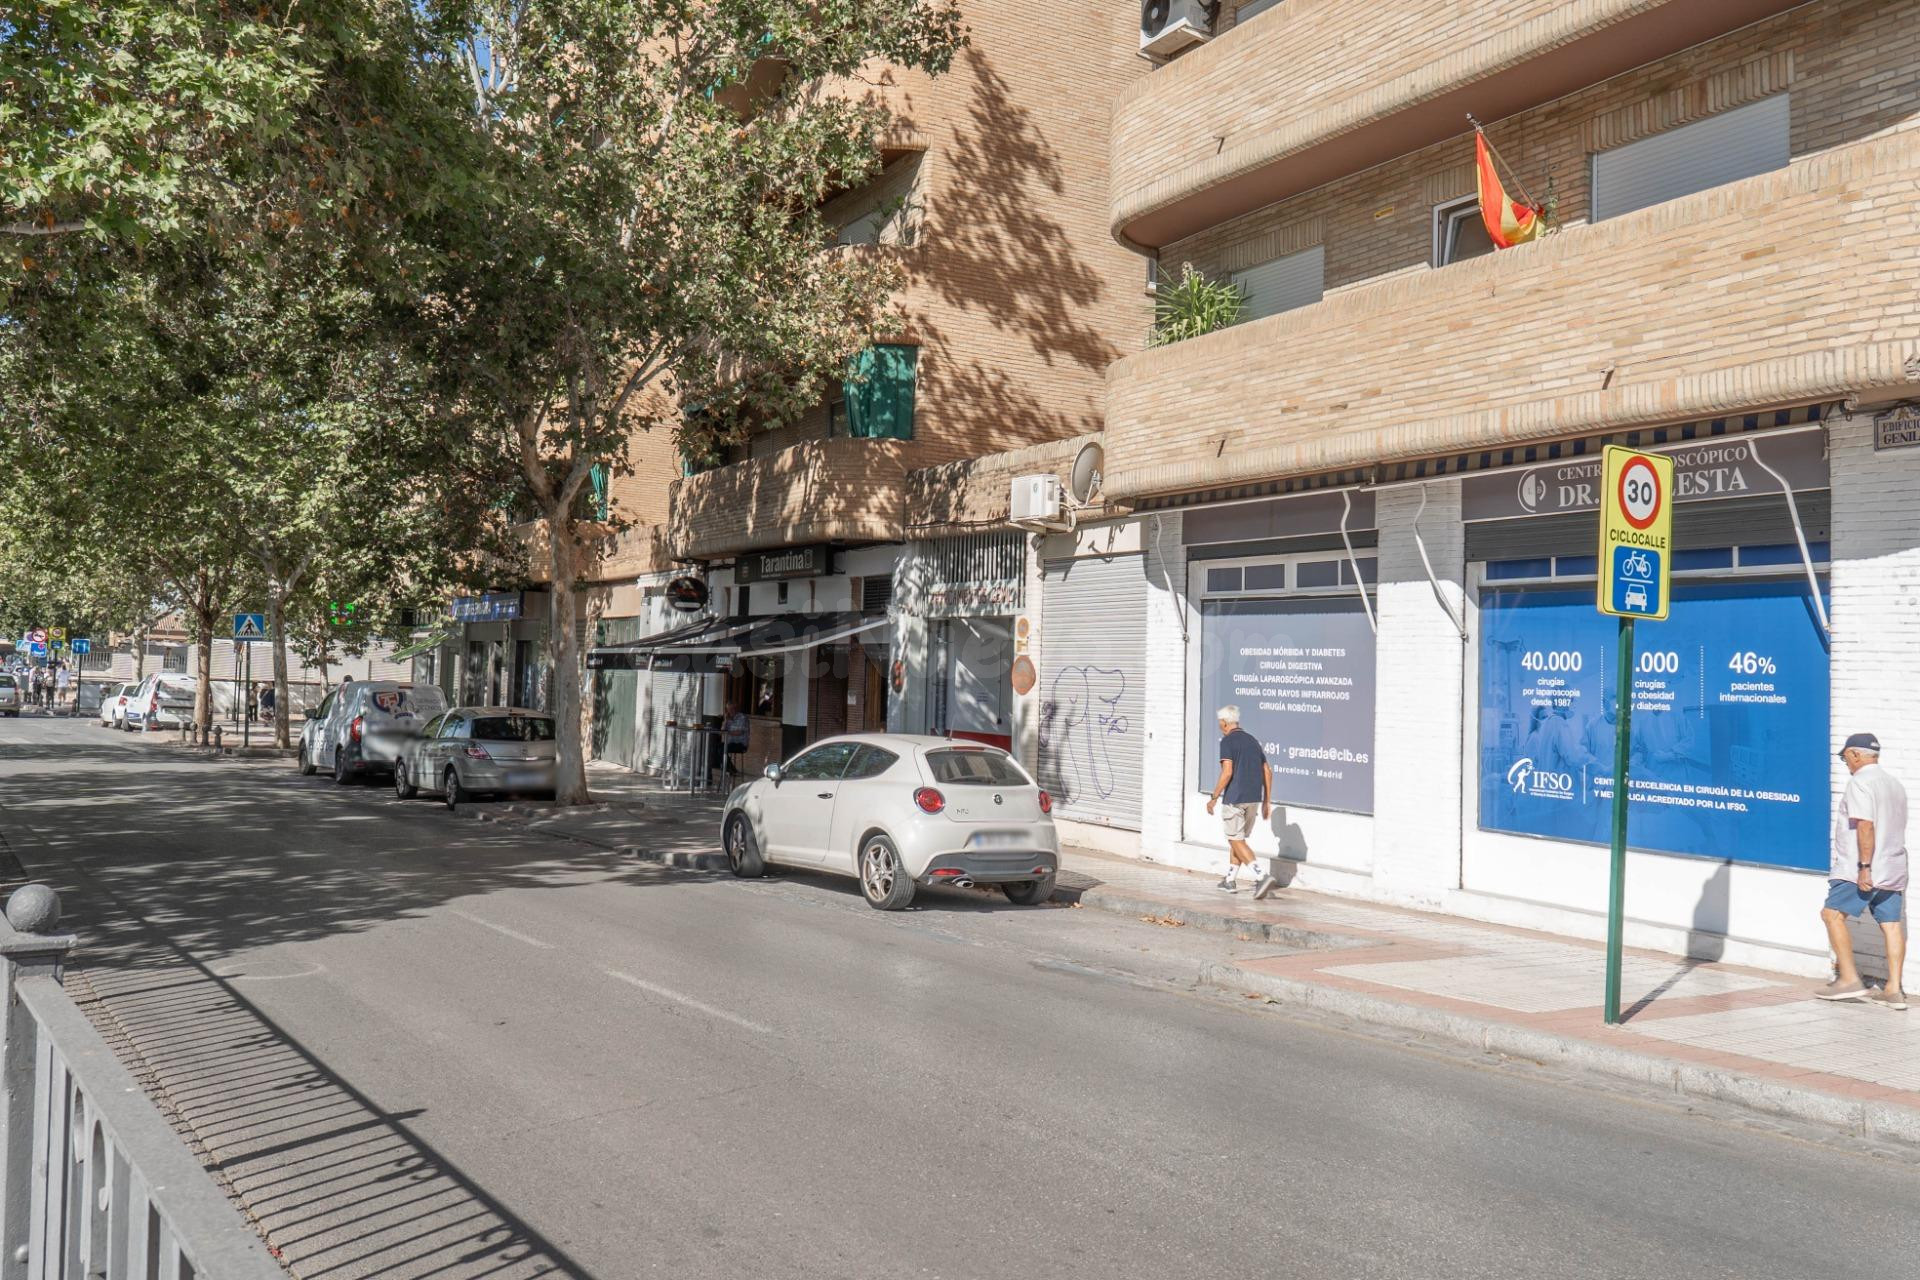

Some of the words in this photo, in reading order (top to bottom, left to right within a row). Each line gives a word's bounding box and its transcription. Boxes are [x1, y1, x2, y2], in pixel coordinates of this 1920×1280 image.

[1557, 464, 1602, 480] CENTR
[1672, 447, 1747, 468] OSCÓPICO
[1558, 484, 1600, 507] DR.
[1672, 466, 1749, 496] ESTA
[1627, 479, 1652, 506] 30
[1609, 528, 1666, 549] CICLOCALLE
[760, 551, 804, 573] Tarantina
[1240, 648, 1271, 656] OBESIDAD
[1273, 646, 1303, 656] MÓRBIDA
[1305, 648, 1310, 657] Y
[1311, 648, 1346, 657] DIABETES
[1260, 660, 1286, 670] CIRUGÍA
[1288, 661, 1323, 671] DIGESTIVA
[1521, 651, 1582, 671] 40.000
[1635, 652, 1679, 673] .000
[1728, 651, 1776, 675] 46%
[1233, 673, 1259, 682] CIRUGÍA
[1260, 674, 1314, 685] LAPAROSCÓPICA
[1316, 677, 1353, 686] AVANZADA
[1730, 682, 1775, 692] pacientes
[1235, 687, 1261, 697] CIRUGÍA
[1262, 688, 1276, 697] CON
[1277, 689, 1300, 698] RAYOS
[1301, 690, 1350, 700] INFRARROJOS
[1522, 688, 1534, 696] por
[1638, 690, 1675, 700] obesidad
[1719, 693, 1787, 704] internacionales
[1259, 701, 1286, 711] CIRUGÍA
[1287, 702, 1322, 713] ROBÓTICA
[1531, 698, 1553, 707] desde
[1554, 698, 1571, 707] 1987
[1637, 702, 1671, 711] diabetes
[1264, 742, 1280, 755] 491
[1288, 746, 1369, 764] granada@clb.es
[1273, 764, 1309, 776] Barcelona
[1316, 769, 1343, 780] Madrid
[1533, 771, 1573, 791] IFSO
[1594, 777, 1615, 786] CENT
[1635, 780, 1682, 792] EXCELENCIA
[1683, 784, 1695, 793] EN
[1695, 785, 1729, 796] CIRUGÍA
[1730, 788, 1742, 797] DE
[1743, 790, 1755, 799] LA
[1756, 791, 1800, 803] OBESIDAD
[1593, 790, 1599, 798] Y
[1600, 791, 1646, 802] METLICA
[1646, 795, 1695, 807] ACREDITADO
[1696, 799, 1714, 809] POR
[1715, 801, 1726, 810] LA
[1727, 802, 1749, 812] IFSO.
